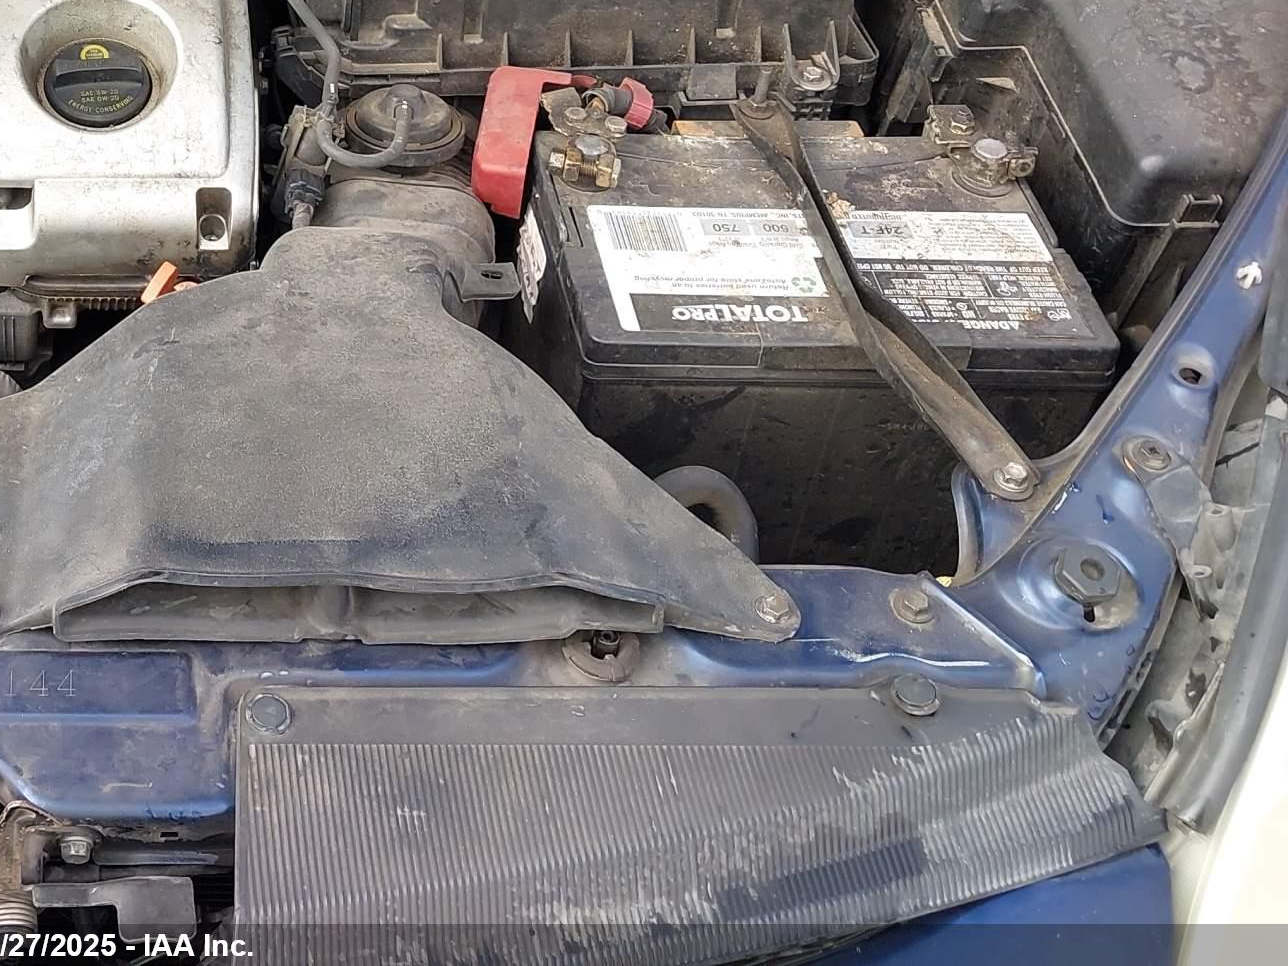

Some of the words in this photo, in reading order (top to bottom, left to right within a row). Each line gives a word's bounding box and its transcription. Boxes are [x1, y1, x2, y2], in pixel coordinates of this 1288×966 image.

[712, 223, 740, 233] 750
[861, 225, 904, 235] 24F-T
[671, 303, 809, 323] TOTALPRO
